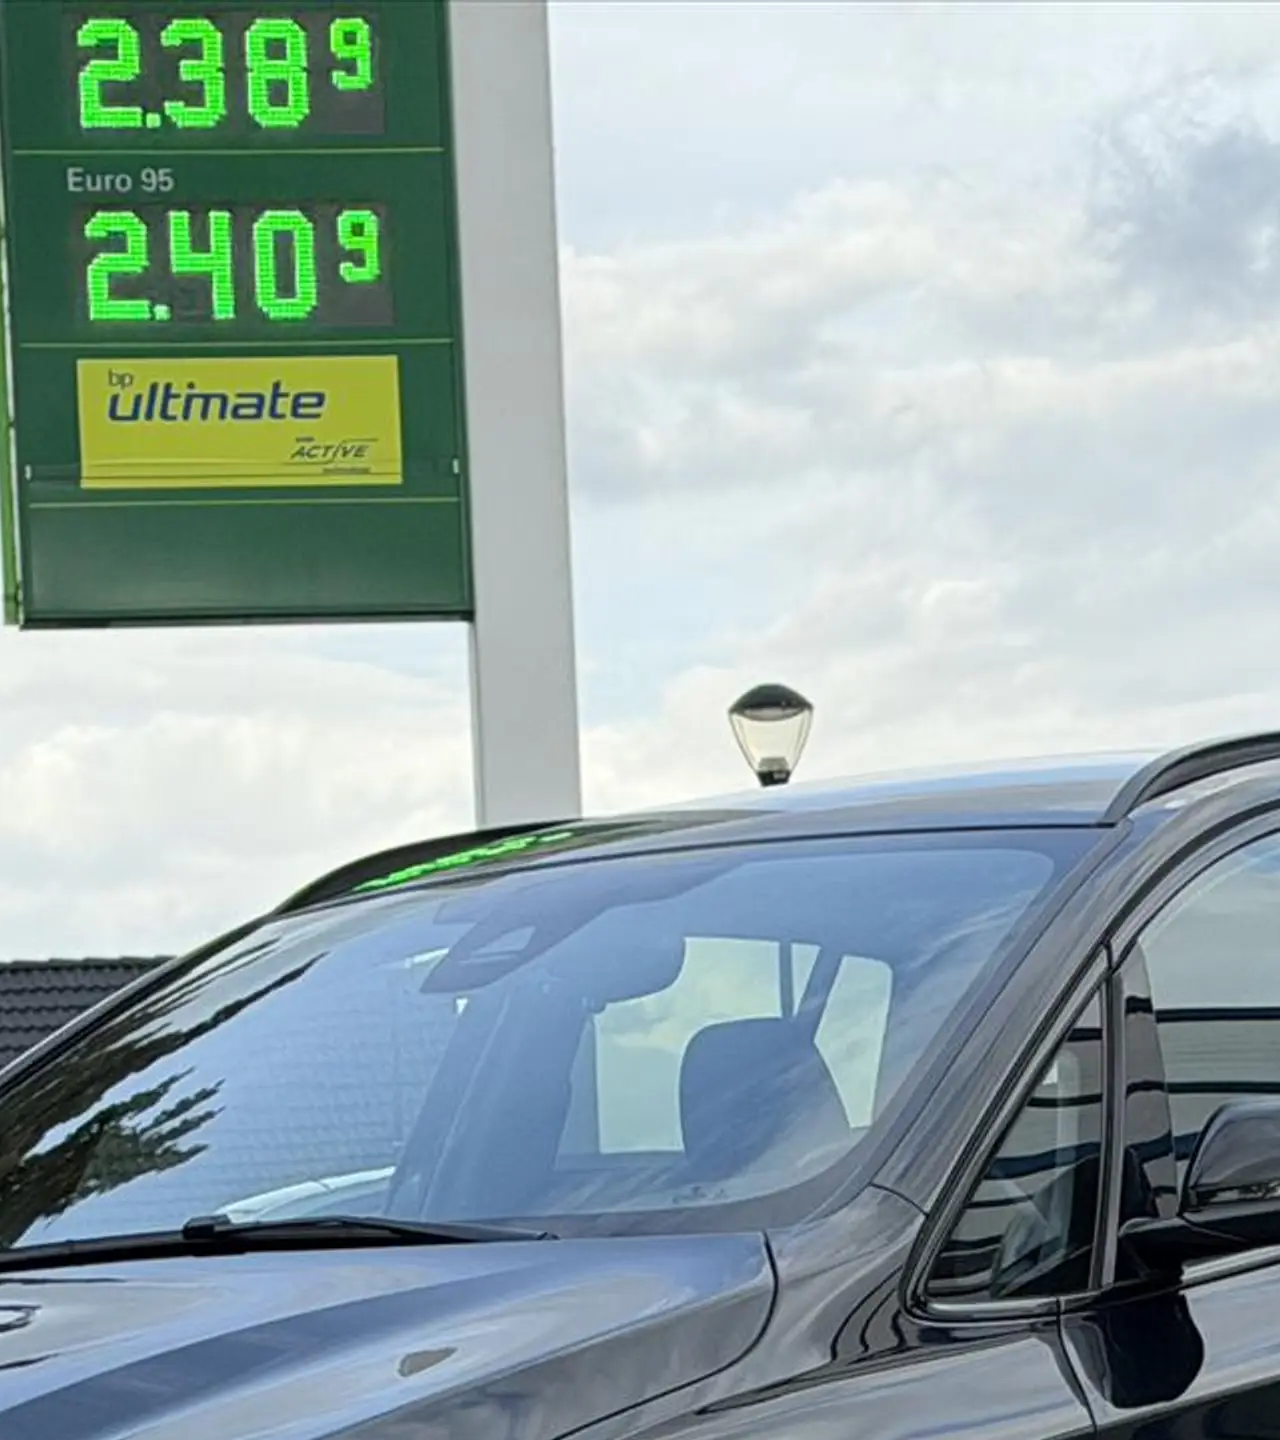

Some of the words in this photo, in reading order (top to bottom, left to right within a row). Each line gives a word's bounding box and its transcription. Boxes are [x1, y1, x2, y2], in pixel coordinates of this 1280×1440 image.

[67, 168, 132, 192] Euro
[140, 168, 175, 192] 95
[108, 368, 134, 388] bp
[107, 381, 326, 422] ultimate
[290, 444, 370, 460] ACTIVE
